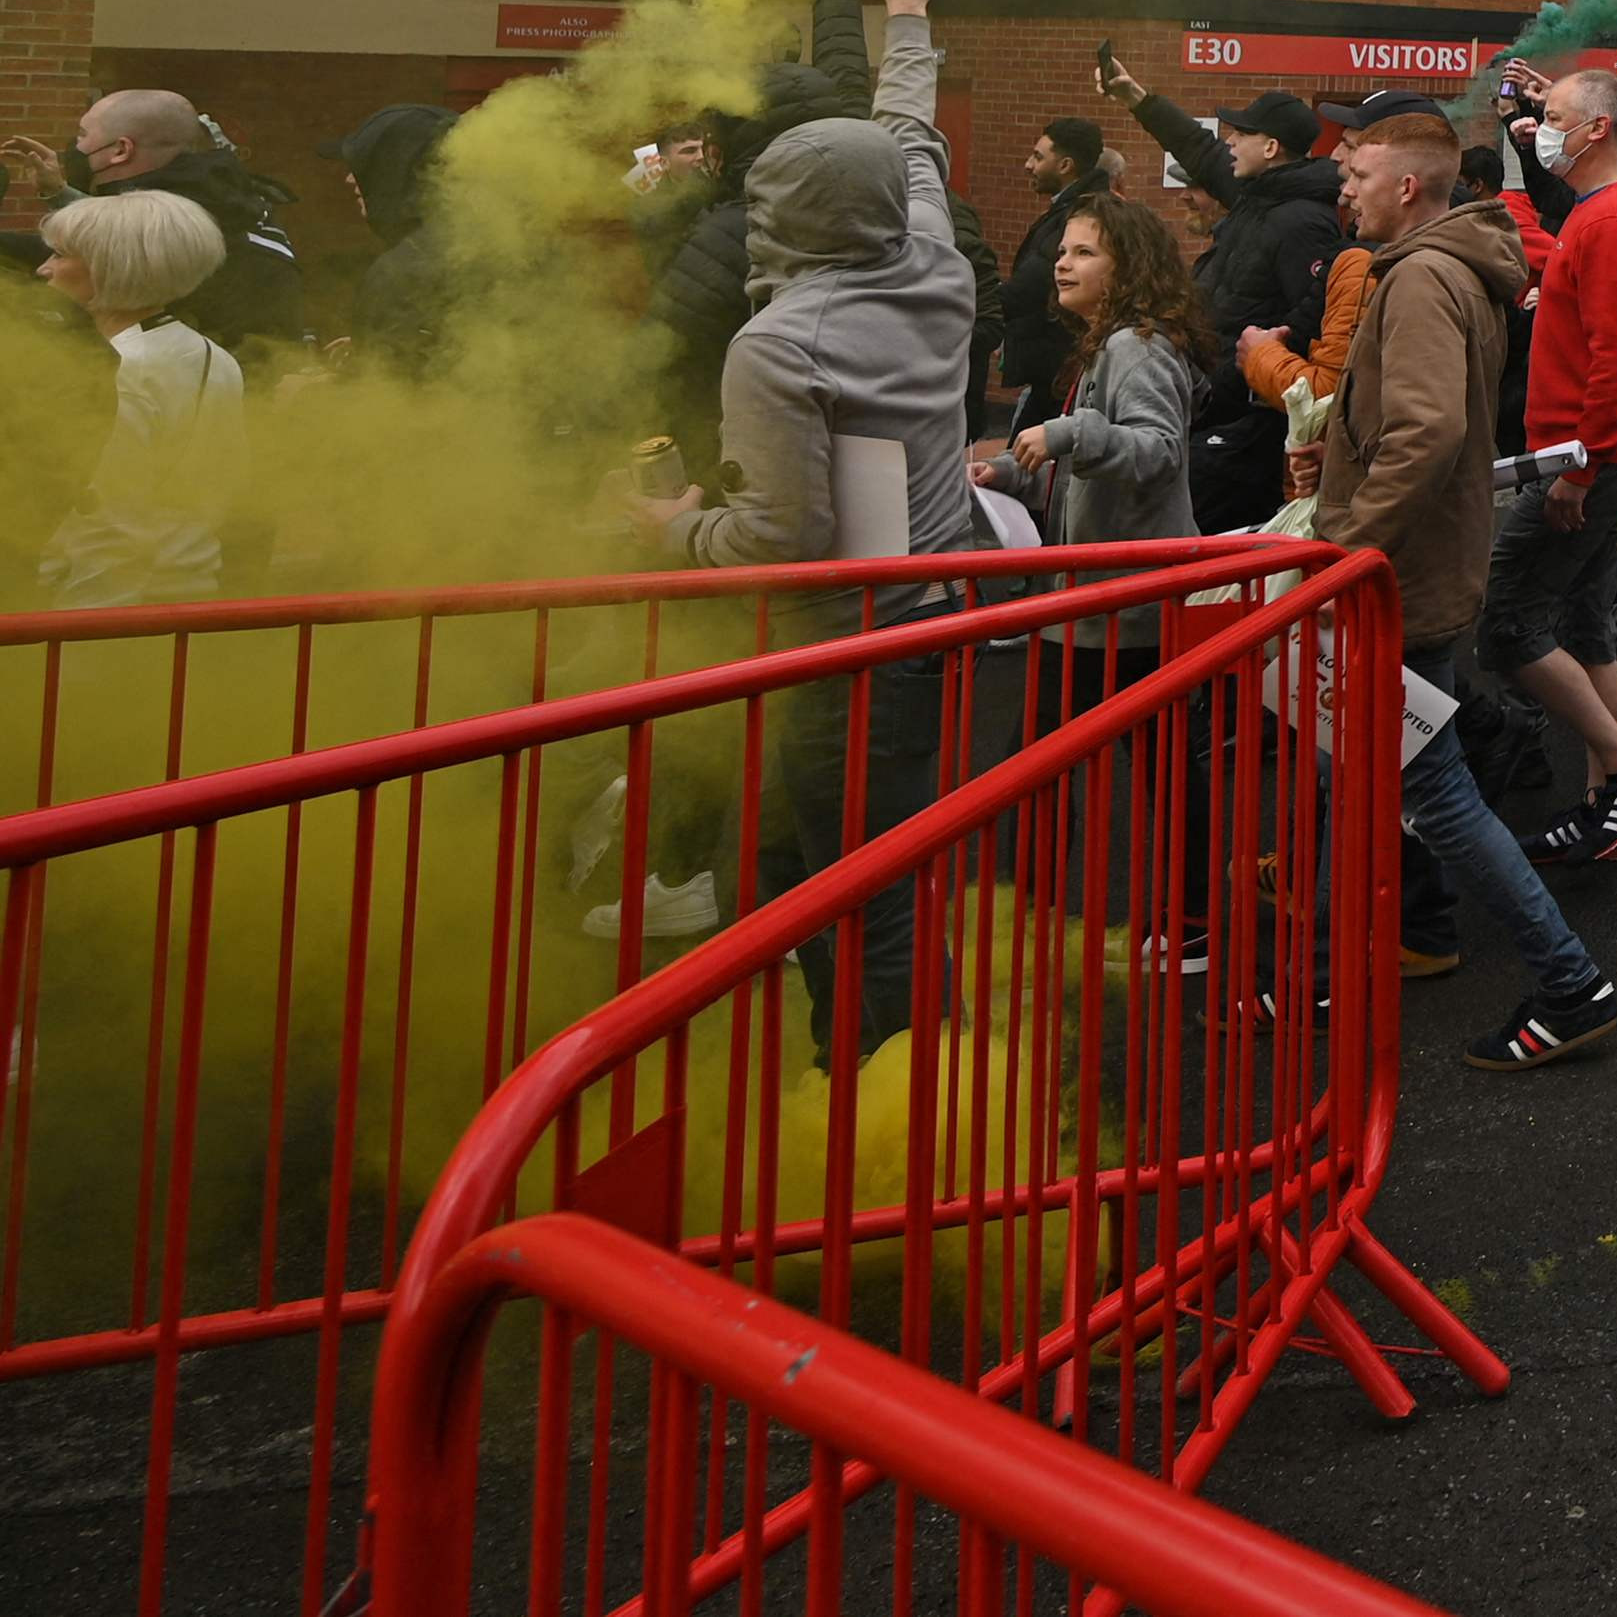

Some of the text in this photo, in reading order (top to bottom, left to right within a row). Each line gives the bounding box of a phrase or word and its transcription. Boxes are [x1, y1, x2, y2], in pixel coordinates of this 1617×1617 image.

[559, 17, 588, 27] ALSO
[1190, 21, 1211, 30] EAST
[506, 27, 539, 37] PRESS
[1187, 37, 1468, 72] E30 VISITORS
